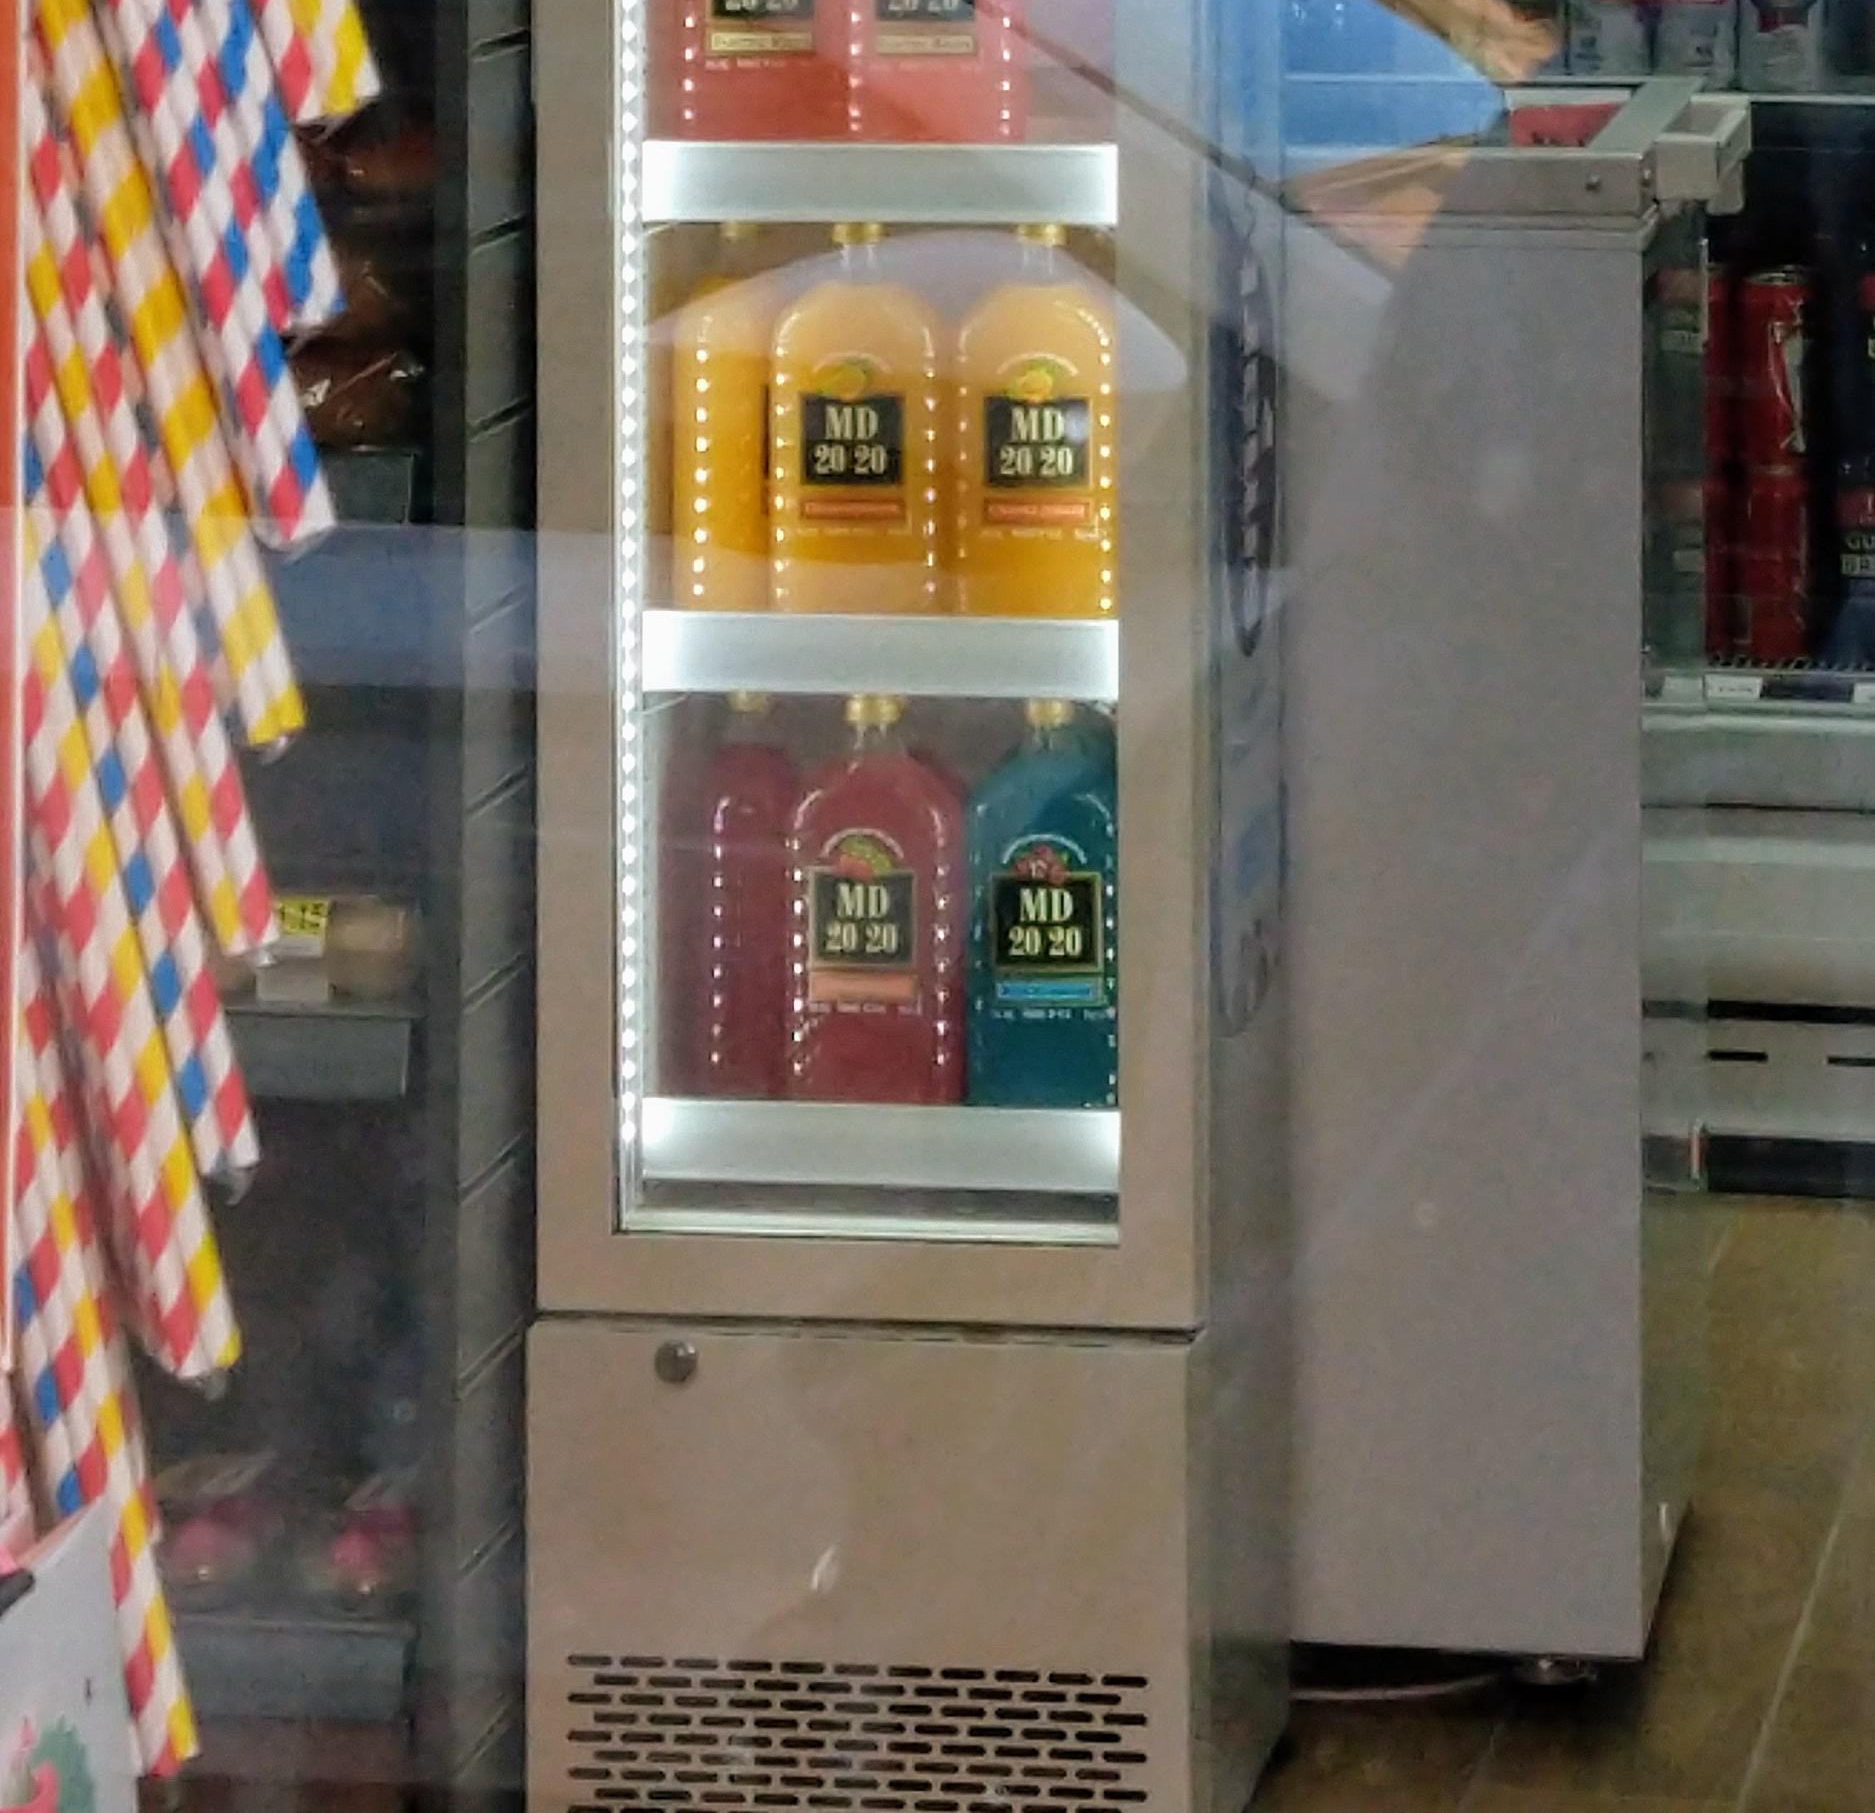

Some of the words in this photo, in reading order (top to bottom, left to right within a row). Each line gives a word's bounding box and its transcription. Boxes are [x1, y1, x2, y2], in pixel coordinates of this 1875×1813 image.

[824, 404, 879, 440] MD
[1010, 407, 1066, 442] MD
[813, 444, 846, 475] 20
[854, 444, 888, 475] 20
[999, 447, 1032, 477] 20
[1040, 447, 1074, 477] 20
[837, 884, 890, 919] MD
[1019, 887, 1075, 922] MD
[825, 922, 857, 954] 20
[865, 922, 899, 955] 20
[1008, 927, 1042, 957] 20
[1048, 927, 1083, 957] 20
